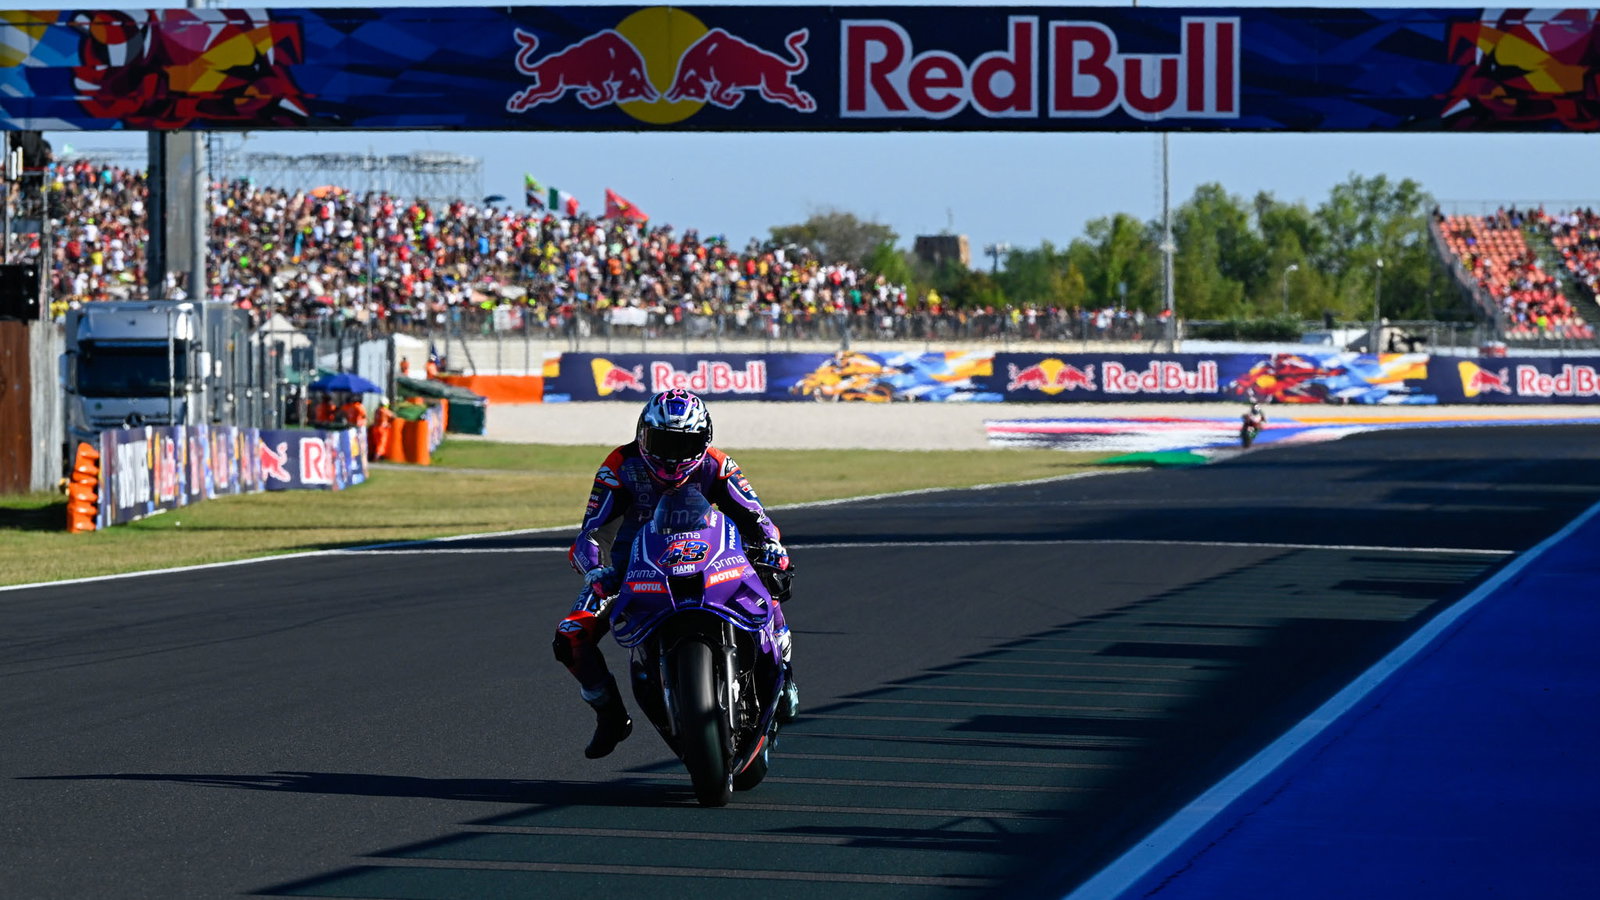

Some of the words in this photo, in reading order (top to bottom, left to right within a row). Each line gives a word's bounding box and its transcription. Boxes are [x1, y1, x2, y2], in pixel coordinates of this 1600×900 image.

[841, 16, 1038, 118] Red
[1049, 16, 1240, 119] Bull
[651, 361, 708, 394] Red
[711, 360, 766, 393] Bull
[1102, 360, 1161, 393] Red
[1161, 360, 1218, 393] Bull
[1517, 364, 1574, 397] Red
[1574, 365, 1600, 397] B
[664, 532, 701, 545] prima
[672, 564, 696, 576] FIAMM
[711, 555, 746, 572] prima
[625, 570, 657, 582] prima
[709, 569, 741, 585] MOTUL
[633, 583, 662, 592] MOTUL
